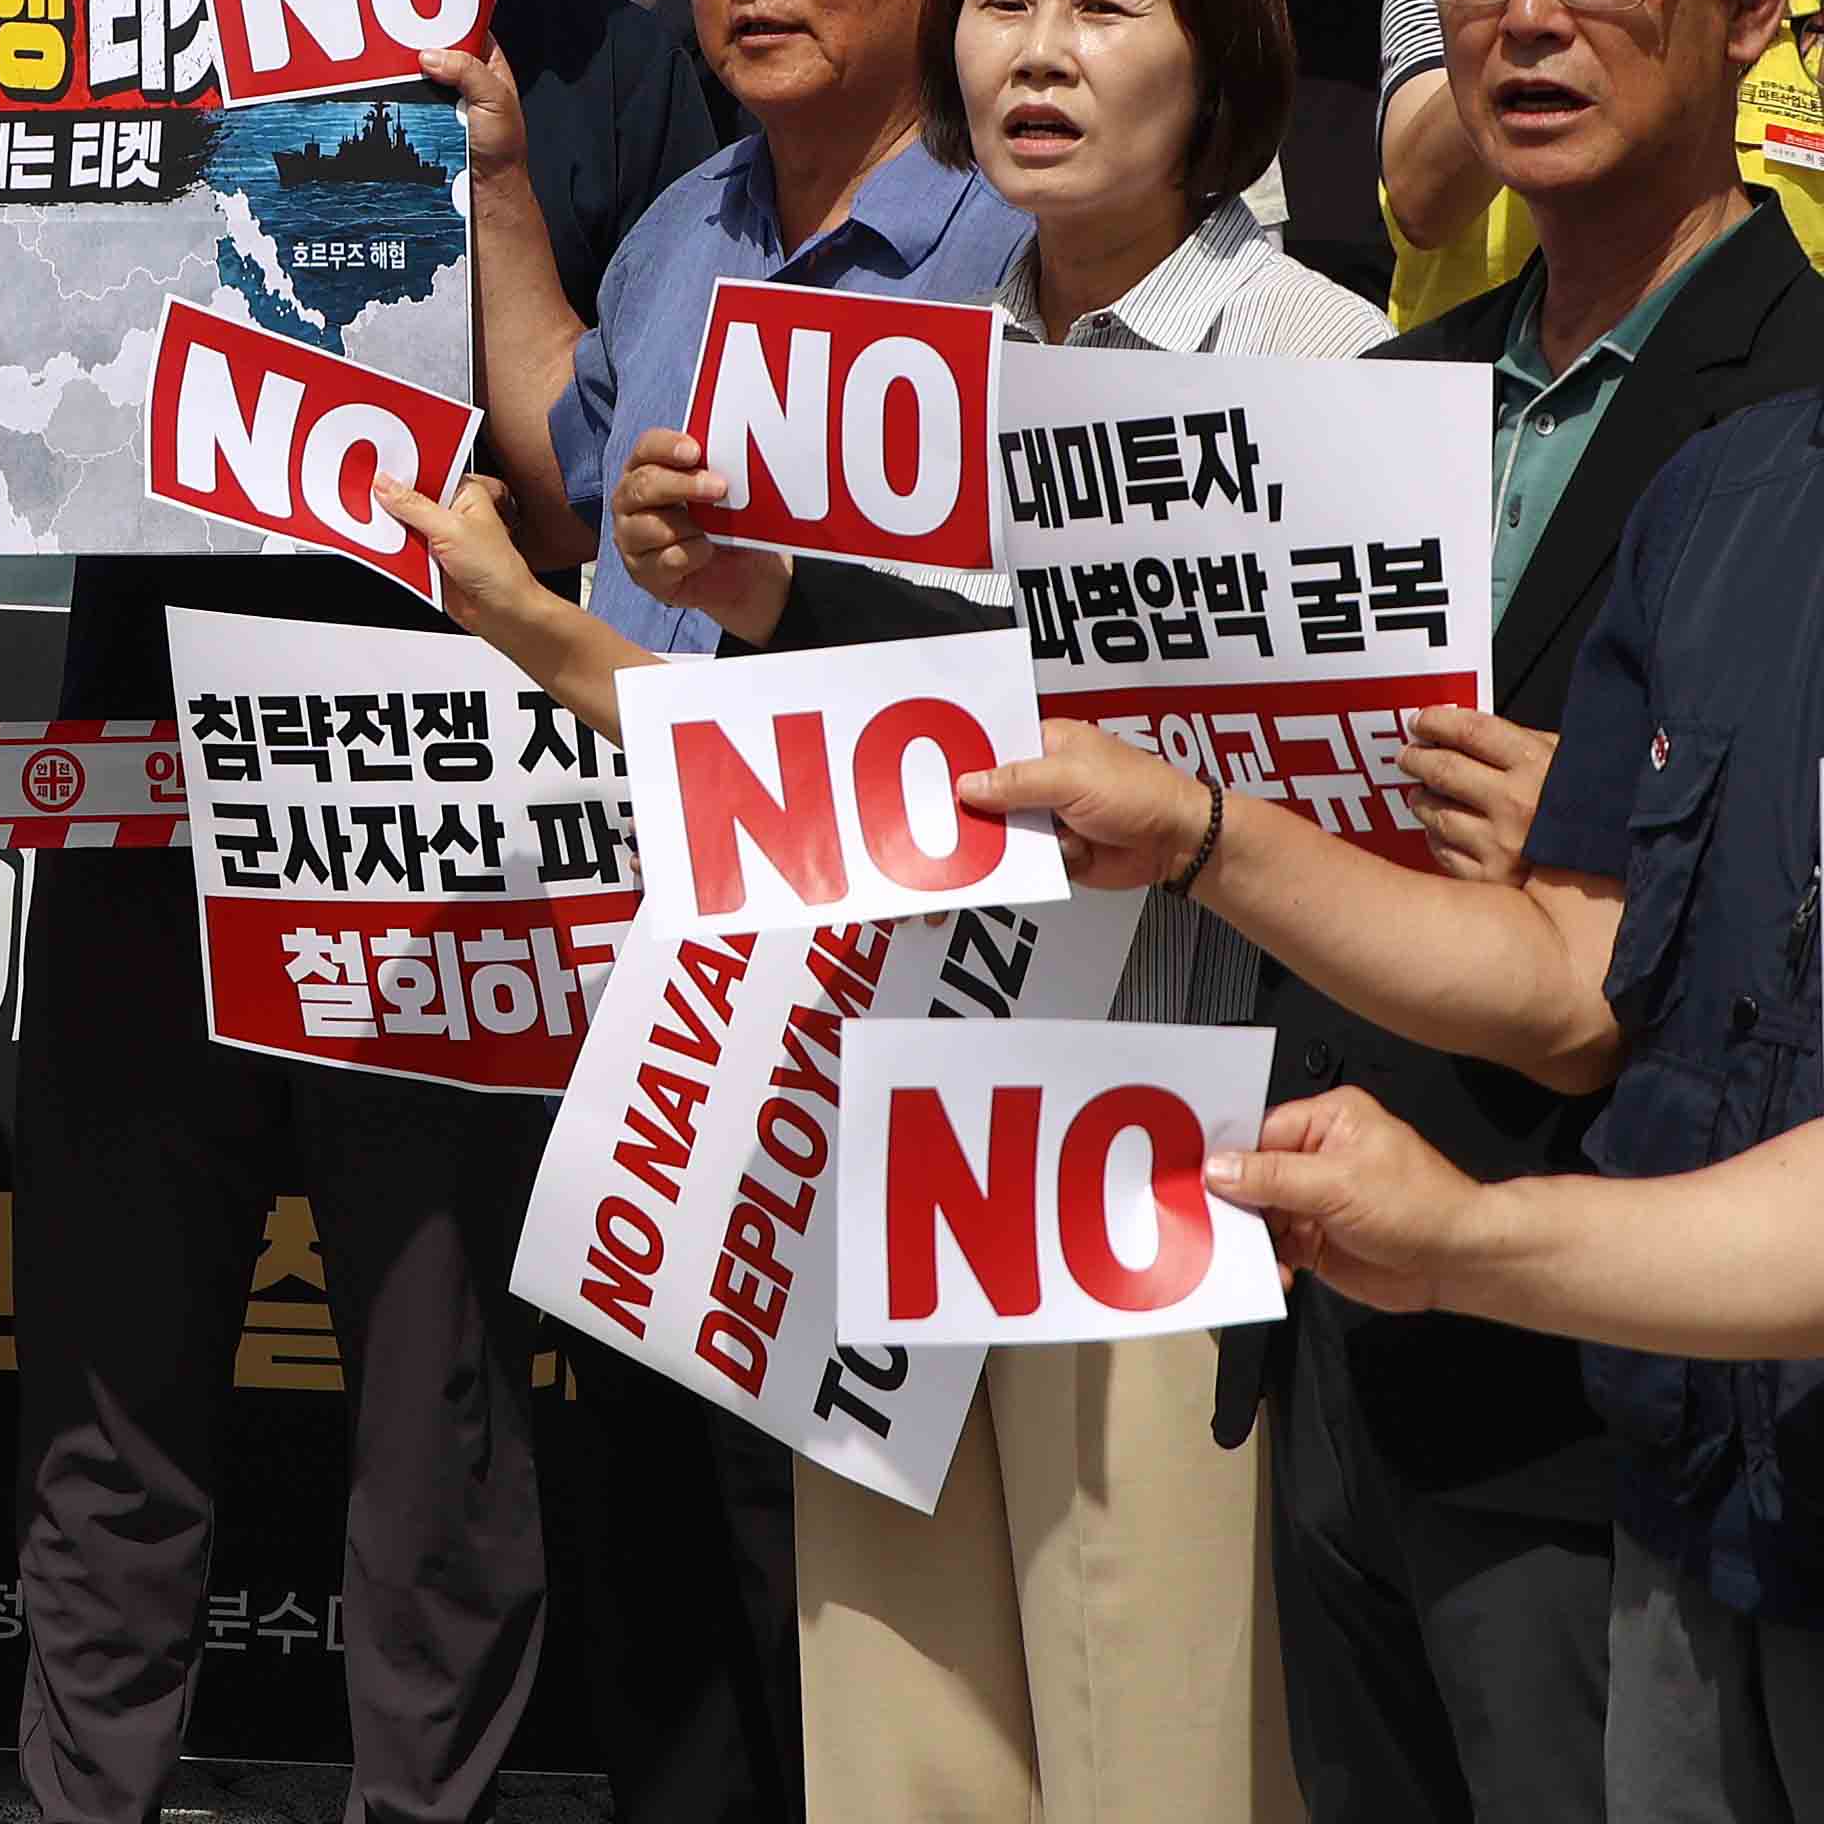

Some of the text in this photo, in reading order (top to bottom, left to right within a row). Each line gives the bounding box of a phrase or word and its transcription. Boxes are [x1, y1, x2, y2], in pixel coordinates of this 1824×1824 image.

[69, 118, 162, 190] 티켓
[291, 240, 406, 270] 호르무즈 해협
[176, 342, 420, 556] NO
[704, 321, 962, 537] NO
[999, 407, 1284, 530] 대미투자,
[1016, 539, 1450, 666] 파병압박 굴복
[187, 690, 630, 784] 침략전쟁 지
[212, 802, 506, 894] 군사자산
[670, 697, 1007, 918] NO
[694, 921, 896, 1399] DEPLOYME
[886, 1082, 1215, 1322] NO
[580, 1193, 666, 1342] NO
